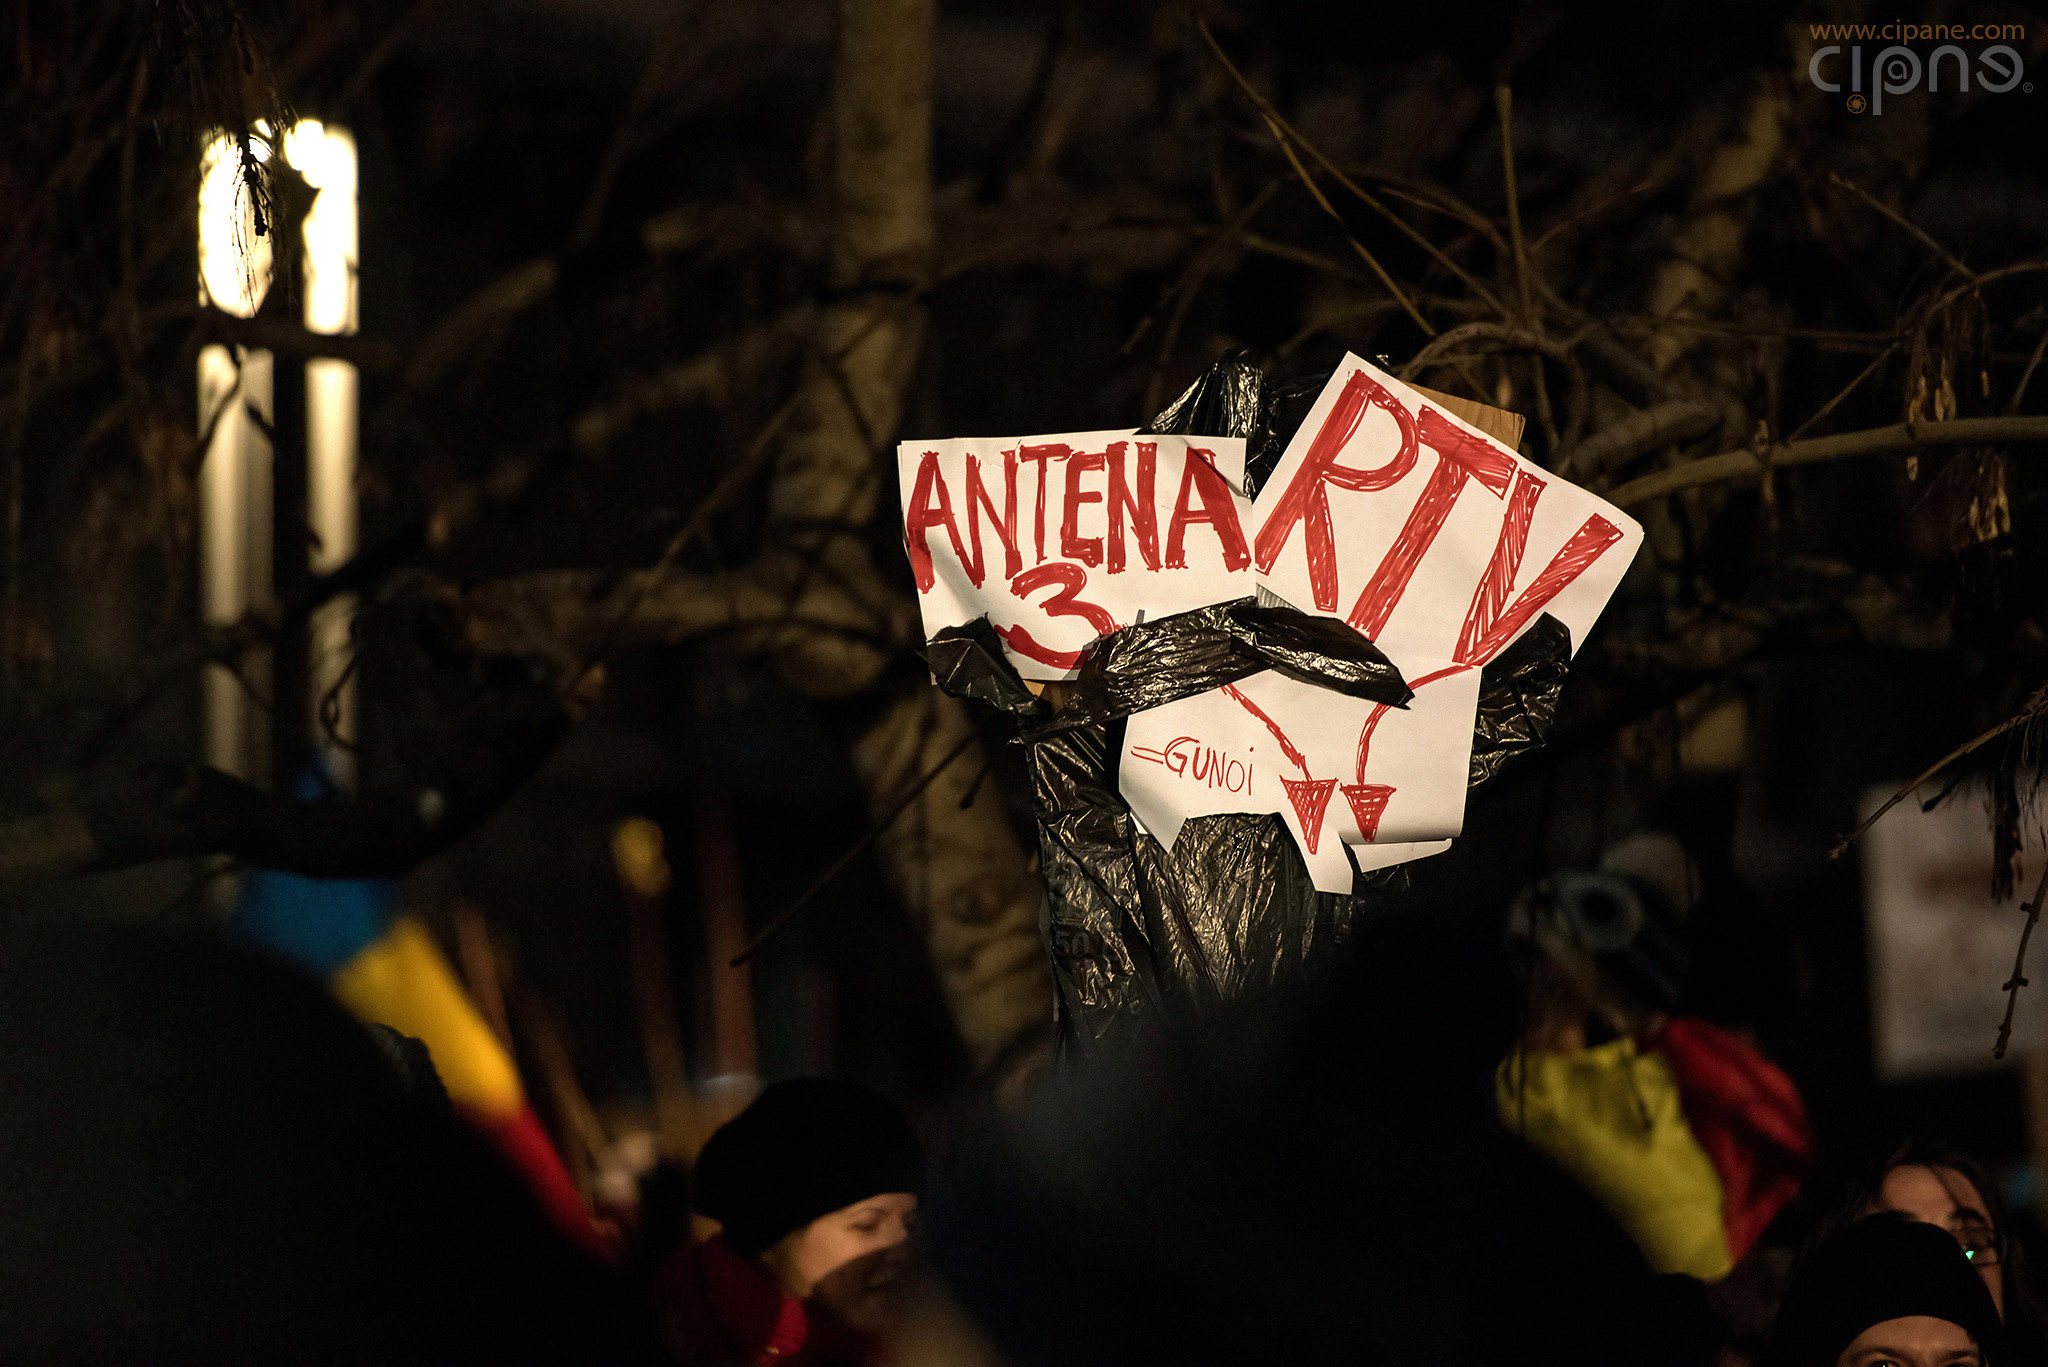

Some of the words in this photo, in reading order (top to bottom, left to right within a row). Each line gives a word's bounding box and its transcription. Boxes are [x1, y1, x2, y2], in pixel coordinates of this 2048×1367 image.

[906, 440, 1252, 594] ANTENA
[1254, 368, 1624, 667] RTV
[993, 561, 1128, 670] 3
